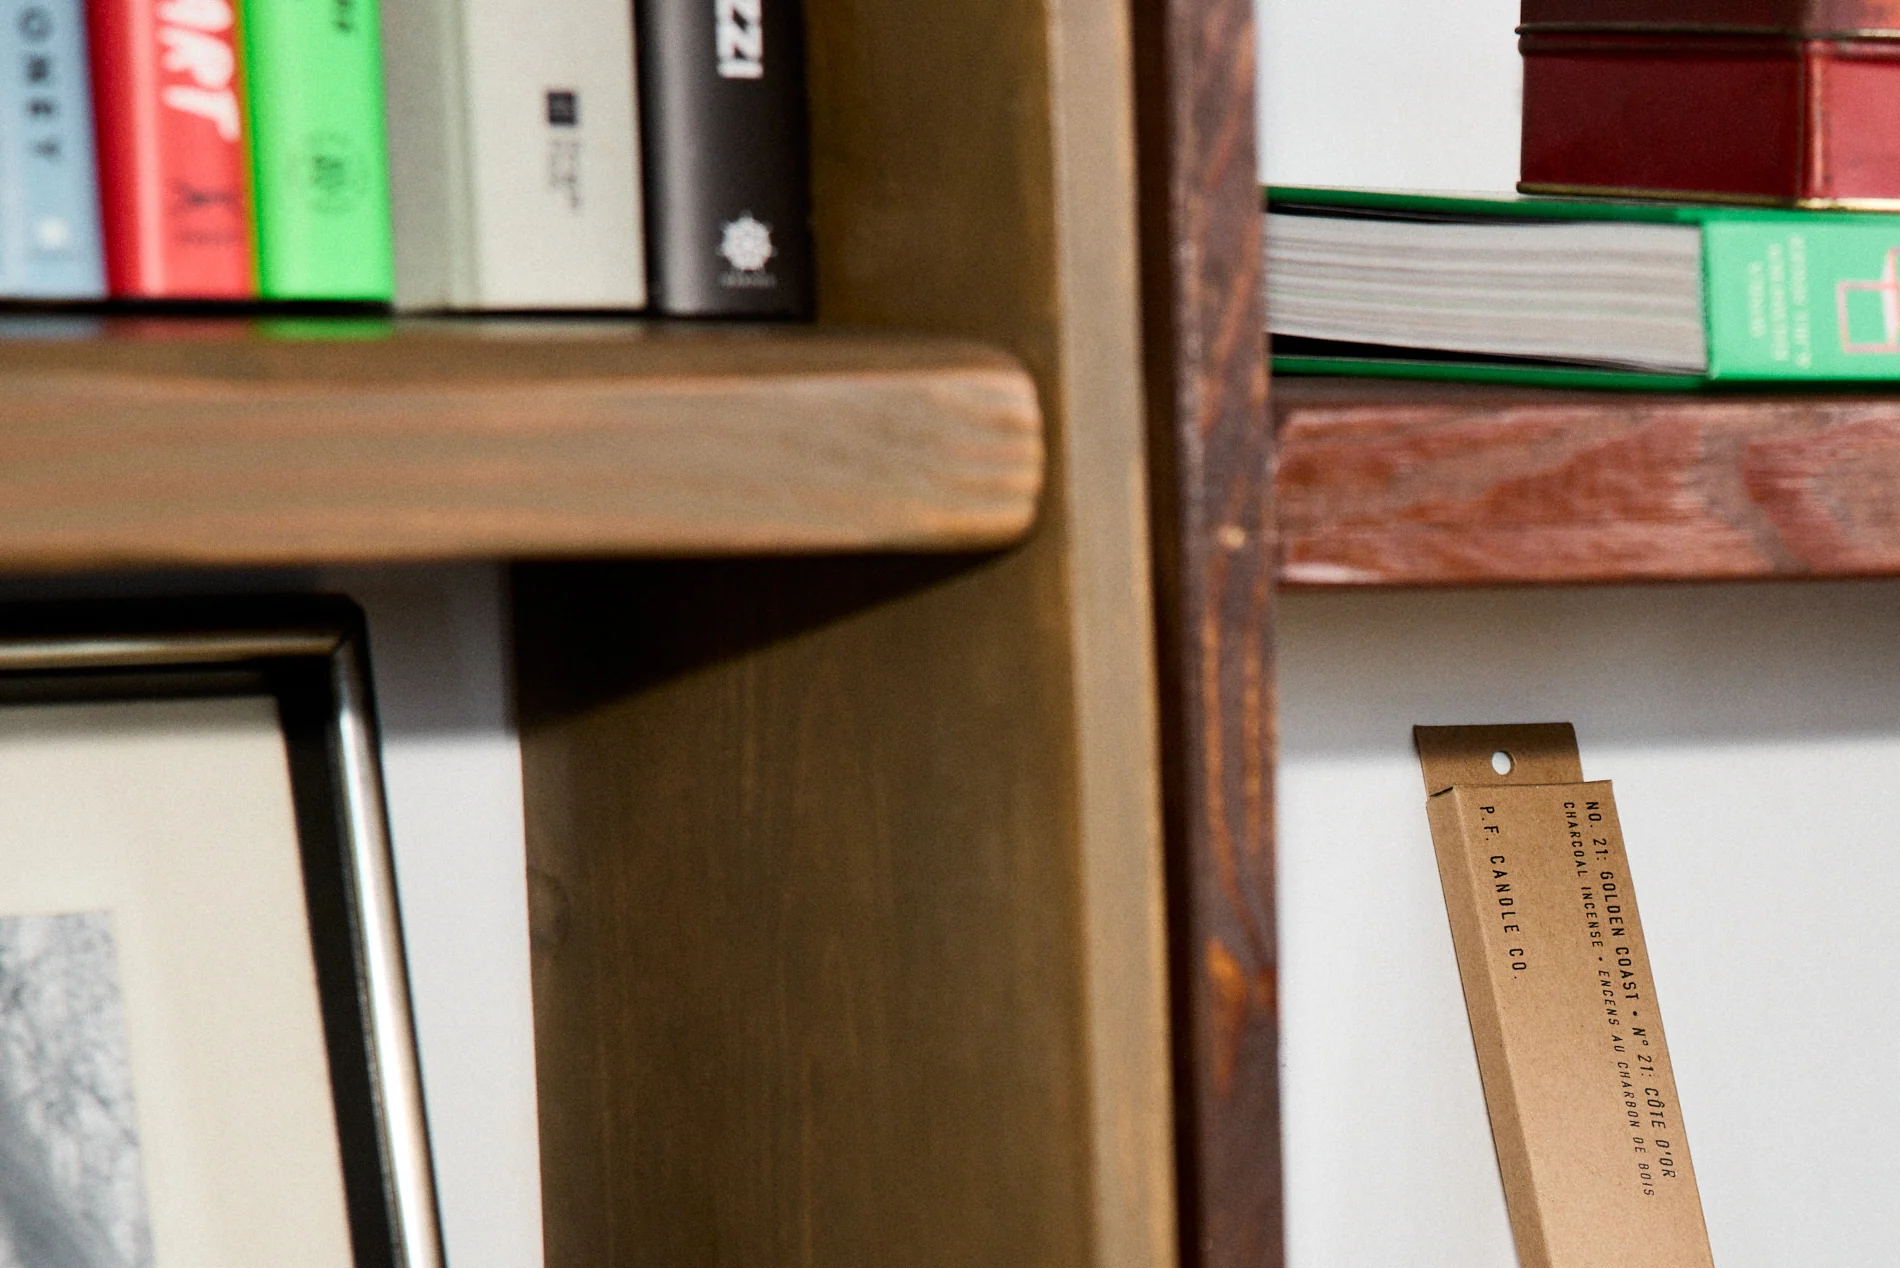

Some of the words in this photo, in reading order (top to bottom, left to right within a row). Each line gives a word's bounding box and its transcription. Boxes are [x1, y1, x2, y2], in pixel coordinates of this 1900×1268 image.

[1479, 805, 1500, 842] P.F.
[1584, 801, 1603, 828] NO.
[1563, 801, 1588, 878] CHARCOAL
[1592, 837, 1609, 861] 21:
[1489, 855, 1521, 934] CANDLE
[1599, 870, 1626, 937] GOLDEN
[1580, 886, 1604, 948] INCENSE
[1508, 947, 1528, 980] CO.
[1614, 946, 1640, 1001] COAST
[1597, 969, 1620, 1026] ENCENS
[1611, 1033, 1626, 1053] AU
[1636, 1053, 1655, 1078] 21:
[1617, 1061, 1641, 1128] CHARBON
[1644, 1087, 1667, 1129] CÔTE
[1632, 1136, 1647, 1154] DE
[1654, 1139, 1677, 1179] D'OR
[1637, 1162, 1655, 1196] BOIS
